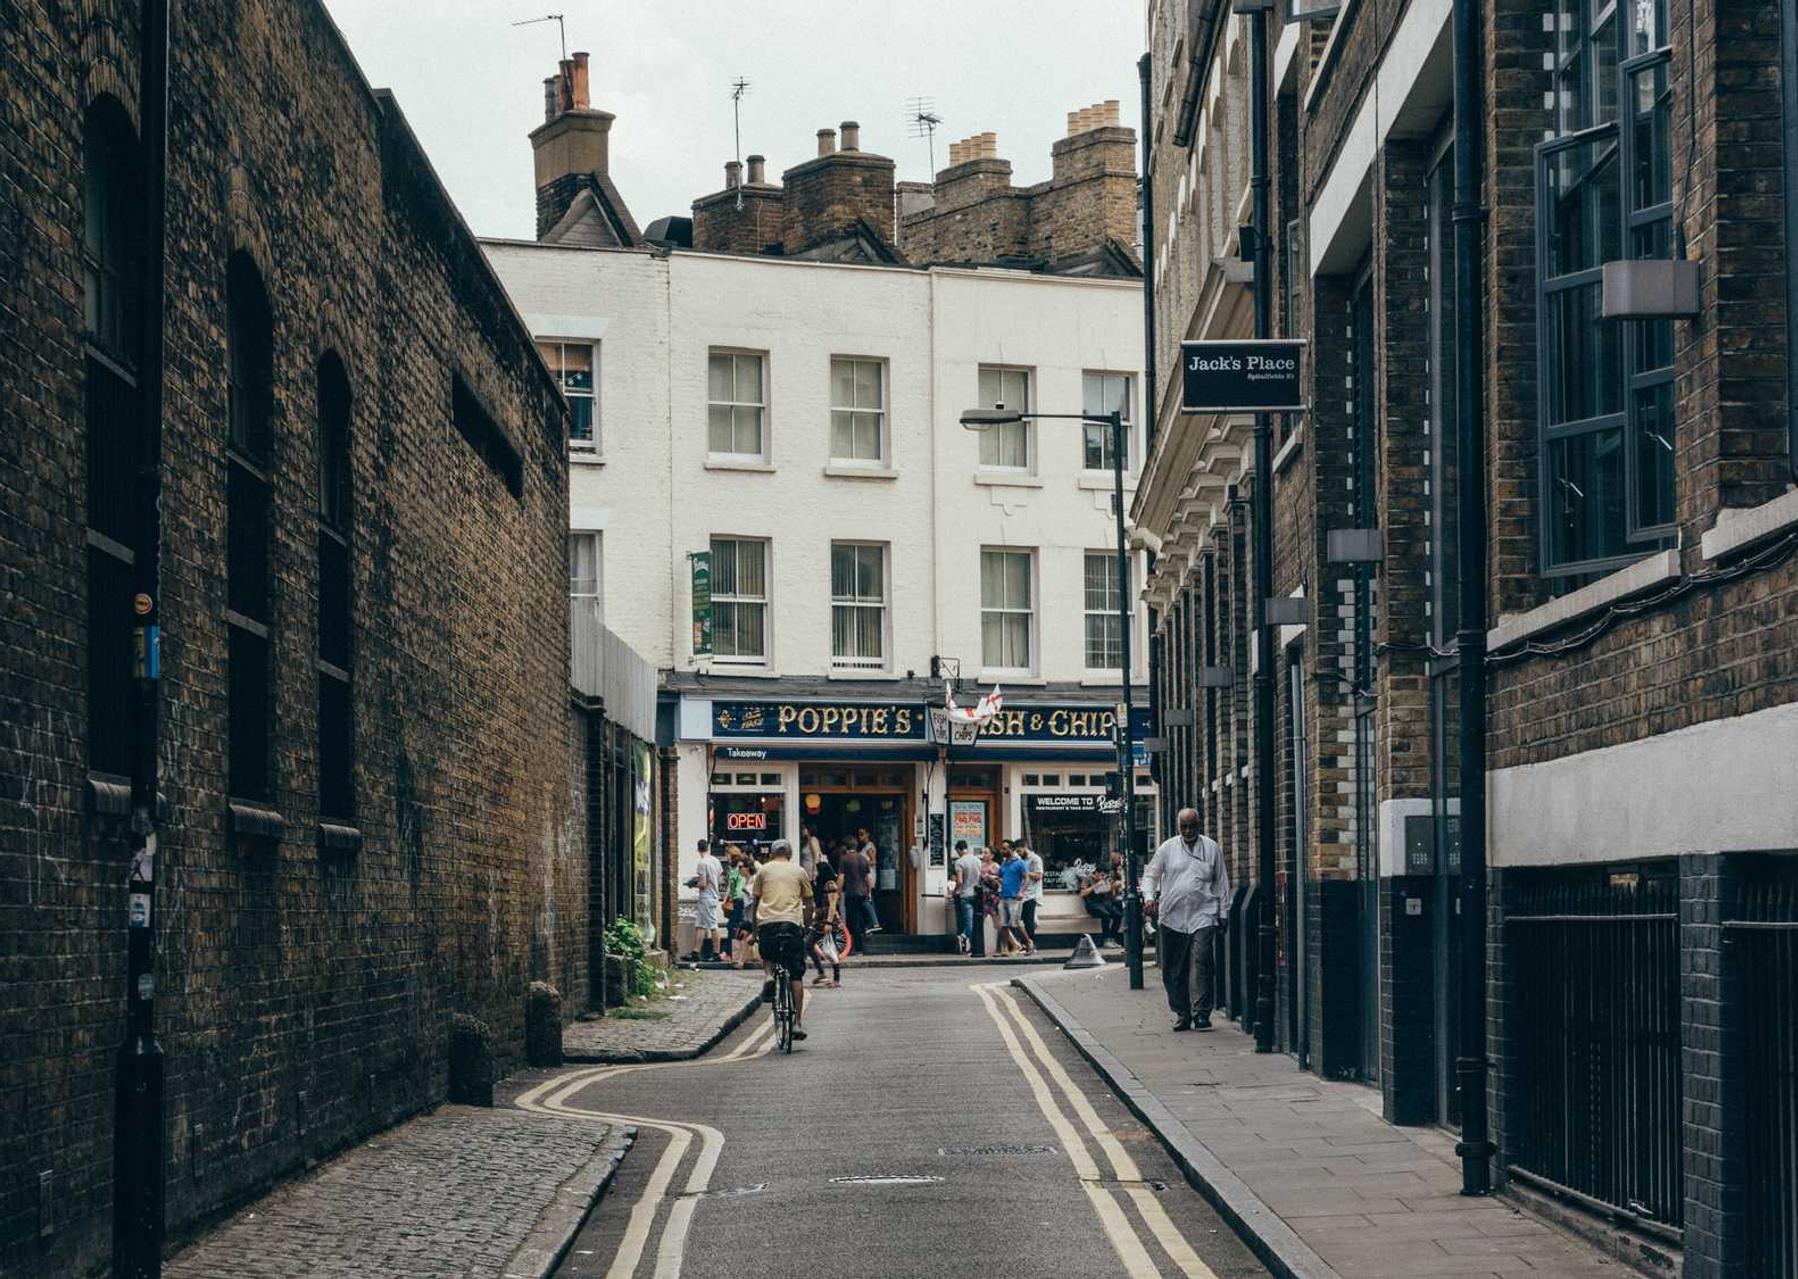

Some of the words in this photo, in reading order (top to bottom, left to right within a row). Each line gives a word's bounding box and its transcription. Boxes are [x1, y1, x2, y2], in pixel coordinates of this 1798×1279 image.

[1189, 356, 1241, 371] Jack's
[1246, 356, 1295, 370] Place
[778, 705, 911, 734] POPPIE'S
[1030, 712, 1044, 731] &
[954, 730, 973, 741] CHIPS
[726, 747, 767, 760] Takeaway
[1037, 797, 1080, 806] WELCOME
[1081, 797, 1094, 806] TO
[729, 814, 765, 829] OPEN
